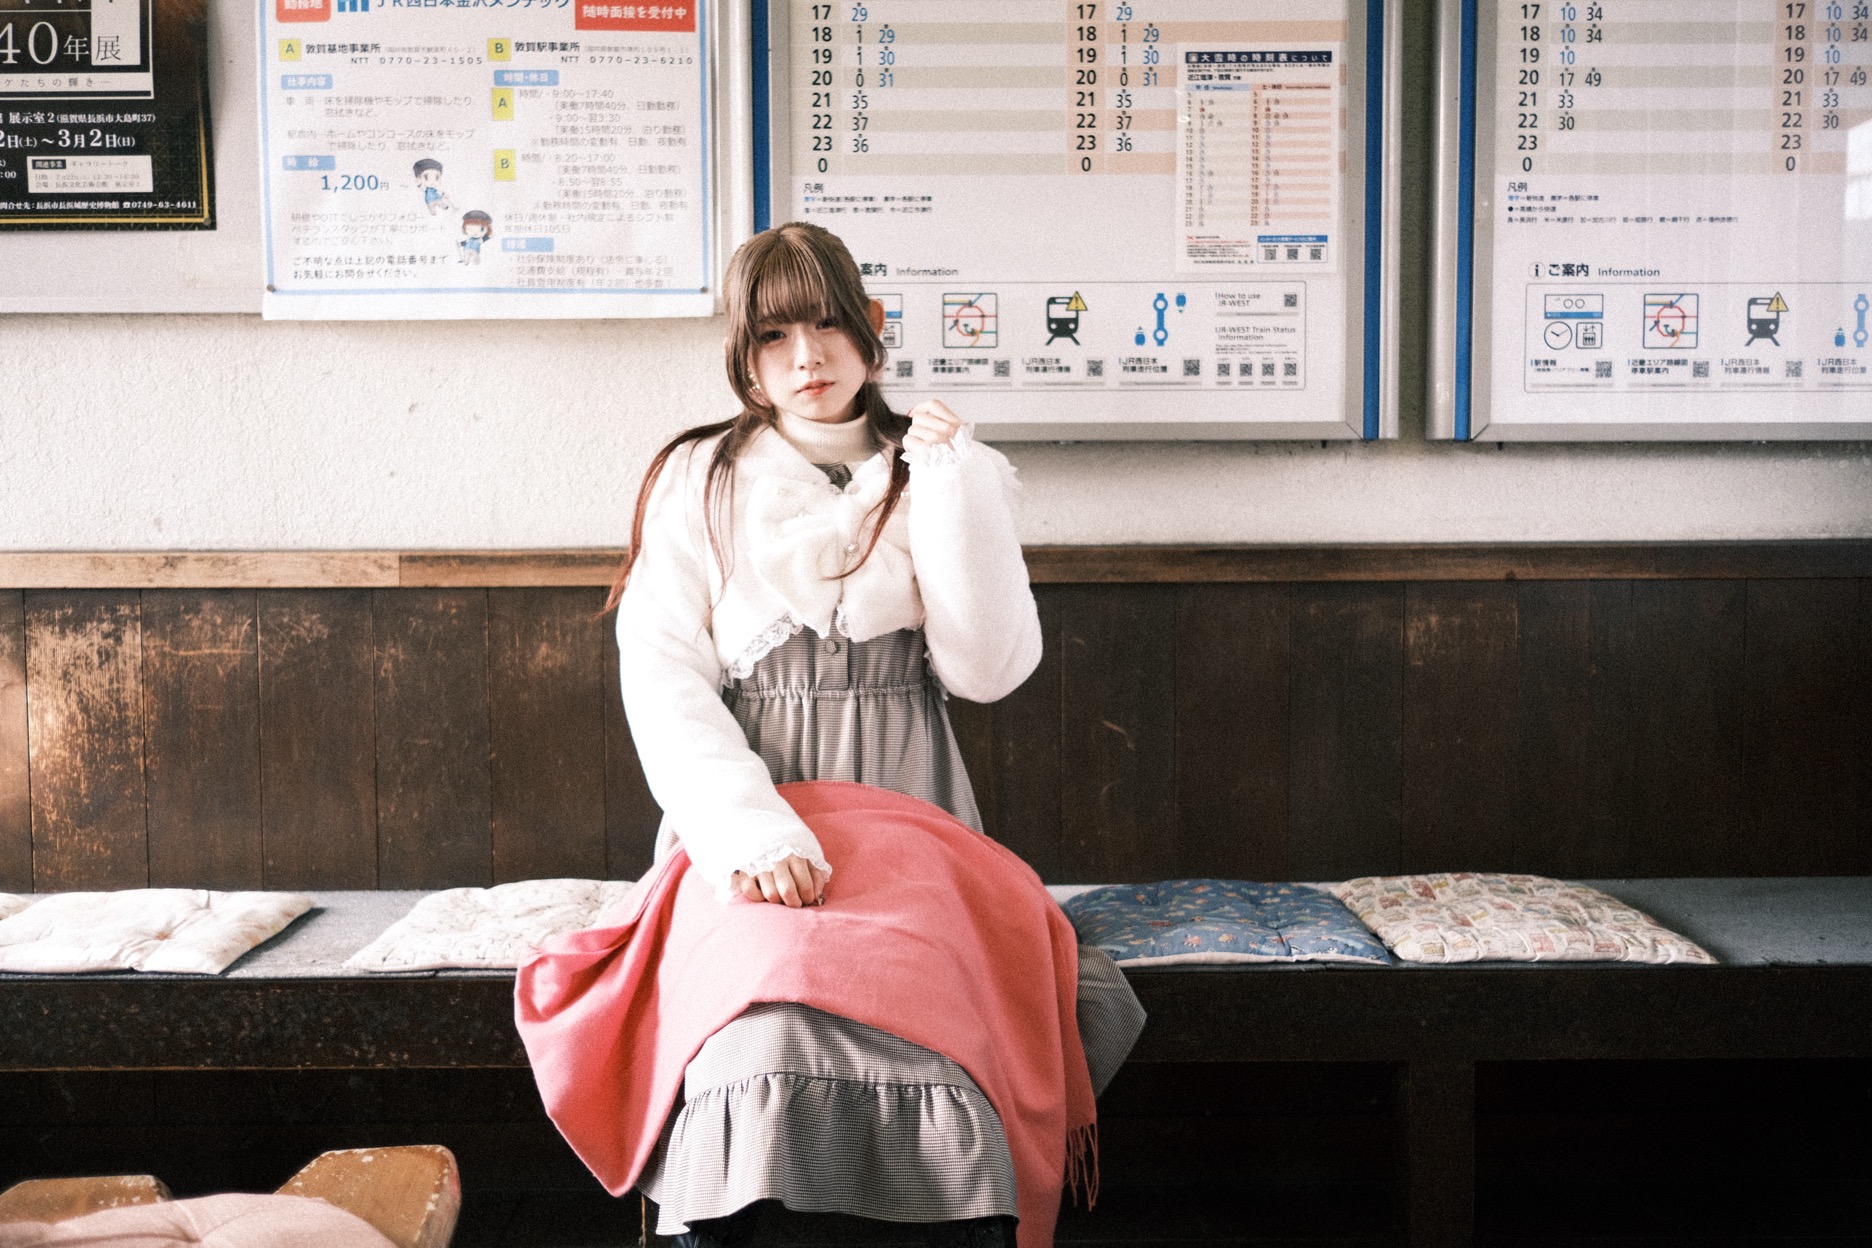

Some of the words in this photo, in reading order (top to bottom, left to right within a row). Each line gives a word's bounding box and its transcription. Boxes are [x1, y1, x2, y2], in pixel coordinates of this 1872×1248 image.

[582, 5, 687, 20] 随時面接を受付中
[812, 5, 831, 20] 17
[851, 8, 868, 21] 29
[1076, 4, 1096, 19] 17
[1116, 6, 1132, 21] 29
[1520, 4, 1540, 19] 17
[1561, 7, 1576, 21] 10
[1586, 7, 1603, 21] 34
[1786, 3, 1806, 19] 17
[1826, 6, 1842, 20] 10
[1852, 6, 1869, 20] 34
[812, 27, 832, 42] 18
[856, 30, 862, 43] 1
[879, 29, 895, 43] 29
[1076, 26, 1097, 41] 18
[1121, 29, 1127, 43] 1
[1143, 28, 1159, 42] 29
[1520, 26, 1540, 41] 18
[1560, 29, 1576, 43] 10
[1586, 29, 1603, 43] 34
[1785, 25, 1805, 40] 18
[1825, 28, 1841, 42] 10
[1851, 27, 1868, 42] 34
[285, 43, 295, 54] A
[306, 43, 381, 55] 敦賀基地事業所
[495, 43, 504, 53] B
[515, 42, 580, 52] 敦賀駅事業所
[351, 57, 369, 65] NTT
[561, 56, 579, 64] NTT
[812, 49, 832, 64] 19
[856, 51, 862, 65] 1
[879, 51, 895, 65] 30
[1076, 48, 1097, 63] 19
[1121, 50, 1127, 64] 1
[1143, 50, 1159, 65] 30
[1520, 48, 1540, 63] 19
[1560, 50, 1575, 65] 10
[1785, 47, 1805, 62] 19
[1825, 50, 1841, 64] 10
[812, 71, 832, 86] 20
[856, 73, 864, 87] 0
[879, 73, 894, 87] 31
[1076, 70, 1097, 85] 20
[1120, 72, 1128, 87] 0
[1143, 72, 1158, 86] 31
[1519, 69, 1539, 85] 20
[1559, 72, 1575, 86] 17
[1585, 72, 1602, 86] 49
[1783, 69, 1804, 84] 20
[1824, 71, 1840, 85] 17
[1850, 71, 1867, 85] 49
[499, 98, 508, 108] A
[812, 92, 831, 107] 21
[852, 95, 868, 109] 35
[1076, 91, 1095, 107] 21
[1116, 94, 1132, 108] 35
[1518, 91, 1537, 107] 21
[1558, 94, 1574, 108] 33
[1782, 91, 1801, 106] 21
[1823, 93, 1839, 107] 33
[812, 114, 832, 129] 22
[852, 117, 868, 131] 37
[1076, 113, 1097, 128] 22
[1116, 116, 1132, 130] 37
[1518, 113, 1538, 128] 22
[1558, 116, 1575, 130] 30
[1781, 113, 1802, 128] 22
[1823, 115, 1839, 129] 30
[812, 136, 832, 151] 23
[852, 139, 869, 152] 36
[1076, 135, 1097, 150] 23
[1116, 137, 1132, 151] 36
[1518, 135, 1538, 150] 23
[1781, 134, 1801, 150] 23
[501, 159, 509, 169] B
[818, 158, 828, 172] 0
[1081, 156, 1091, 172] 0
[1523, 157, 1532, 172] 0
[1785, 156, 1796, 171] 0
[803, 183, 823, 193] 凡例
[1507, 182, 1528, 193] 凡例
[896, 267, 959, 276] Information
[1548, 264, 1589, 277] ご案内
[1598, 267, 1660, 277] Information
